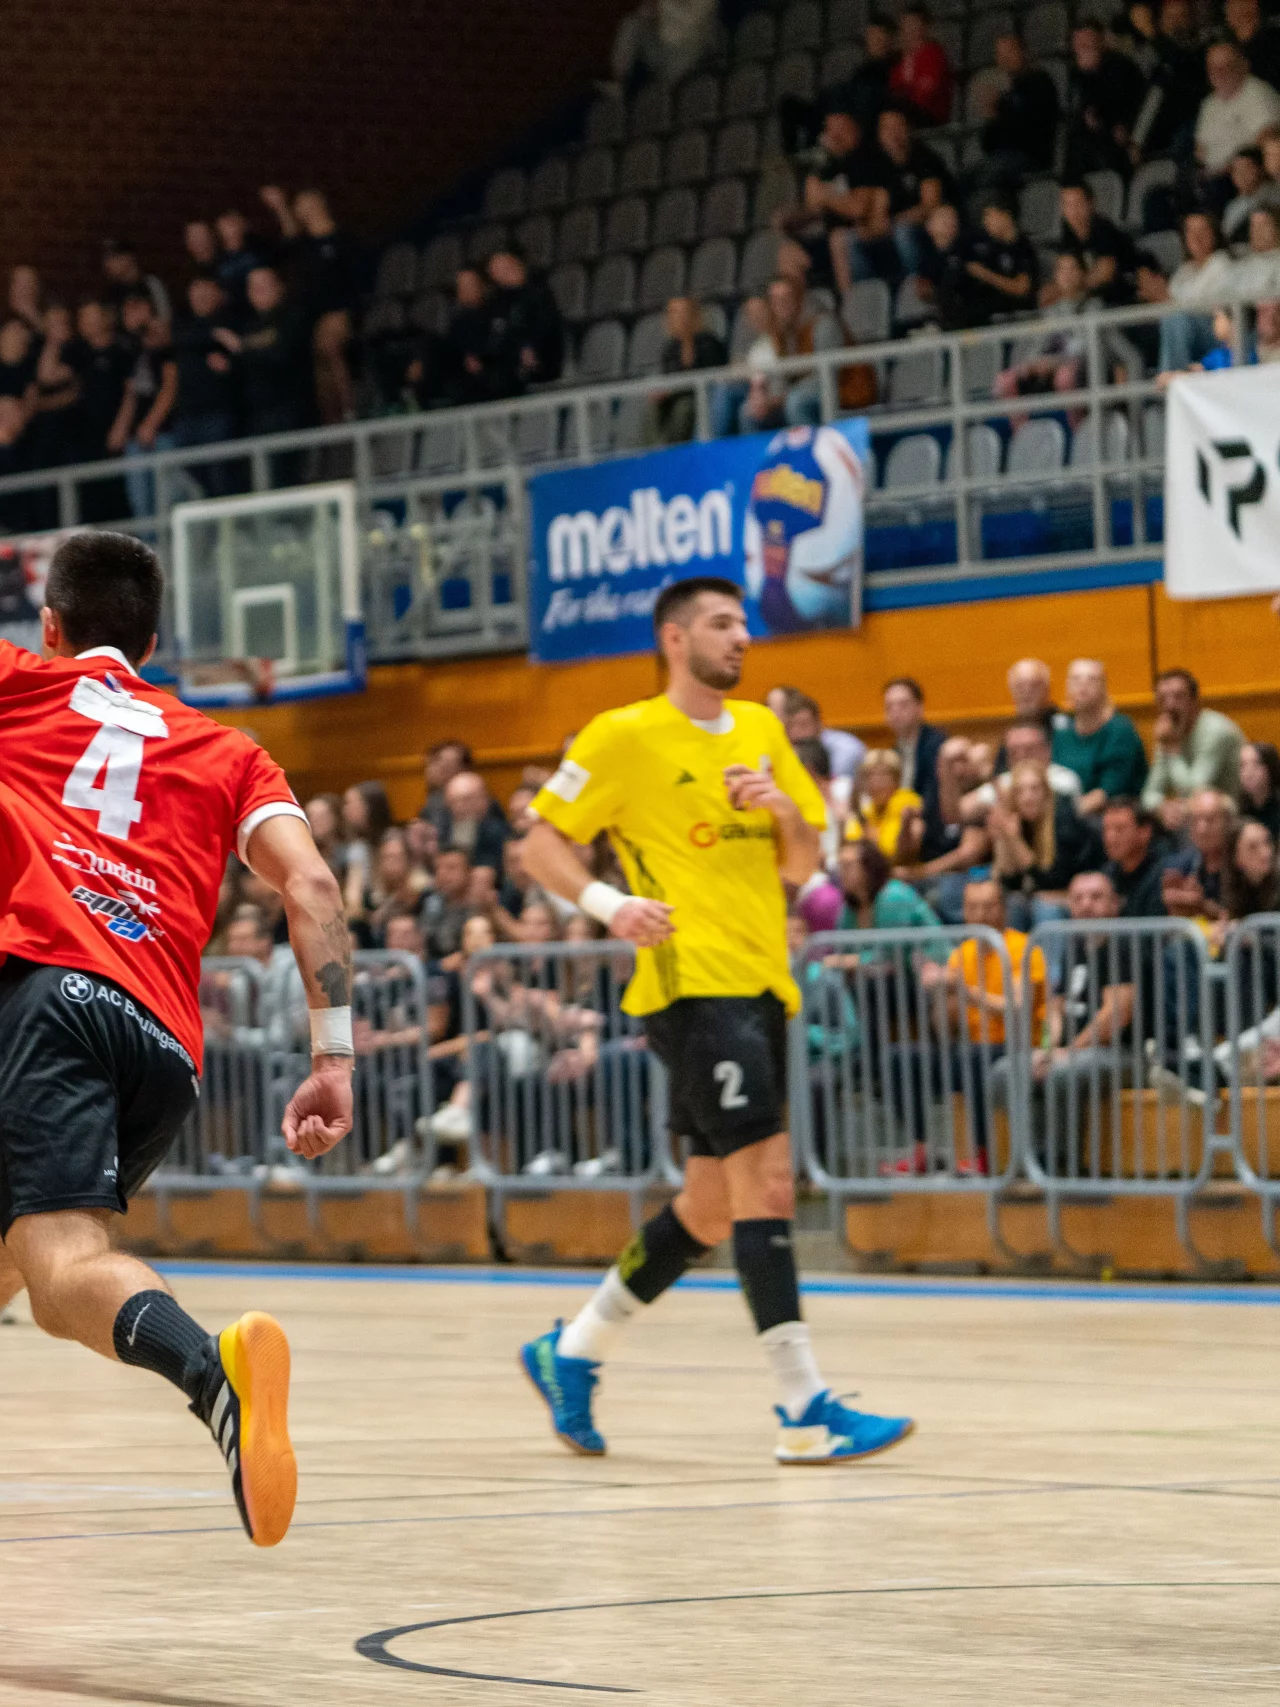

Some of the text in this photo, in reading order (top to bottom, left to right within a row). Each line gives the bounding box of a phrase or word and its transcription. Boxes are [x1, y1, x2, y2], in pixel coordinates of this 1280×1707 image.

[548, 488, 733, 583] molten
[62, 723, 144, 840] 4
[96, 985, 123, 1007] AC
[713, 1060, 749, 1110] 2
